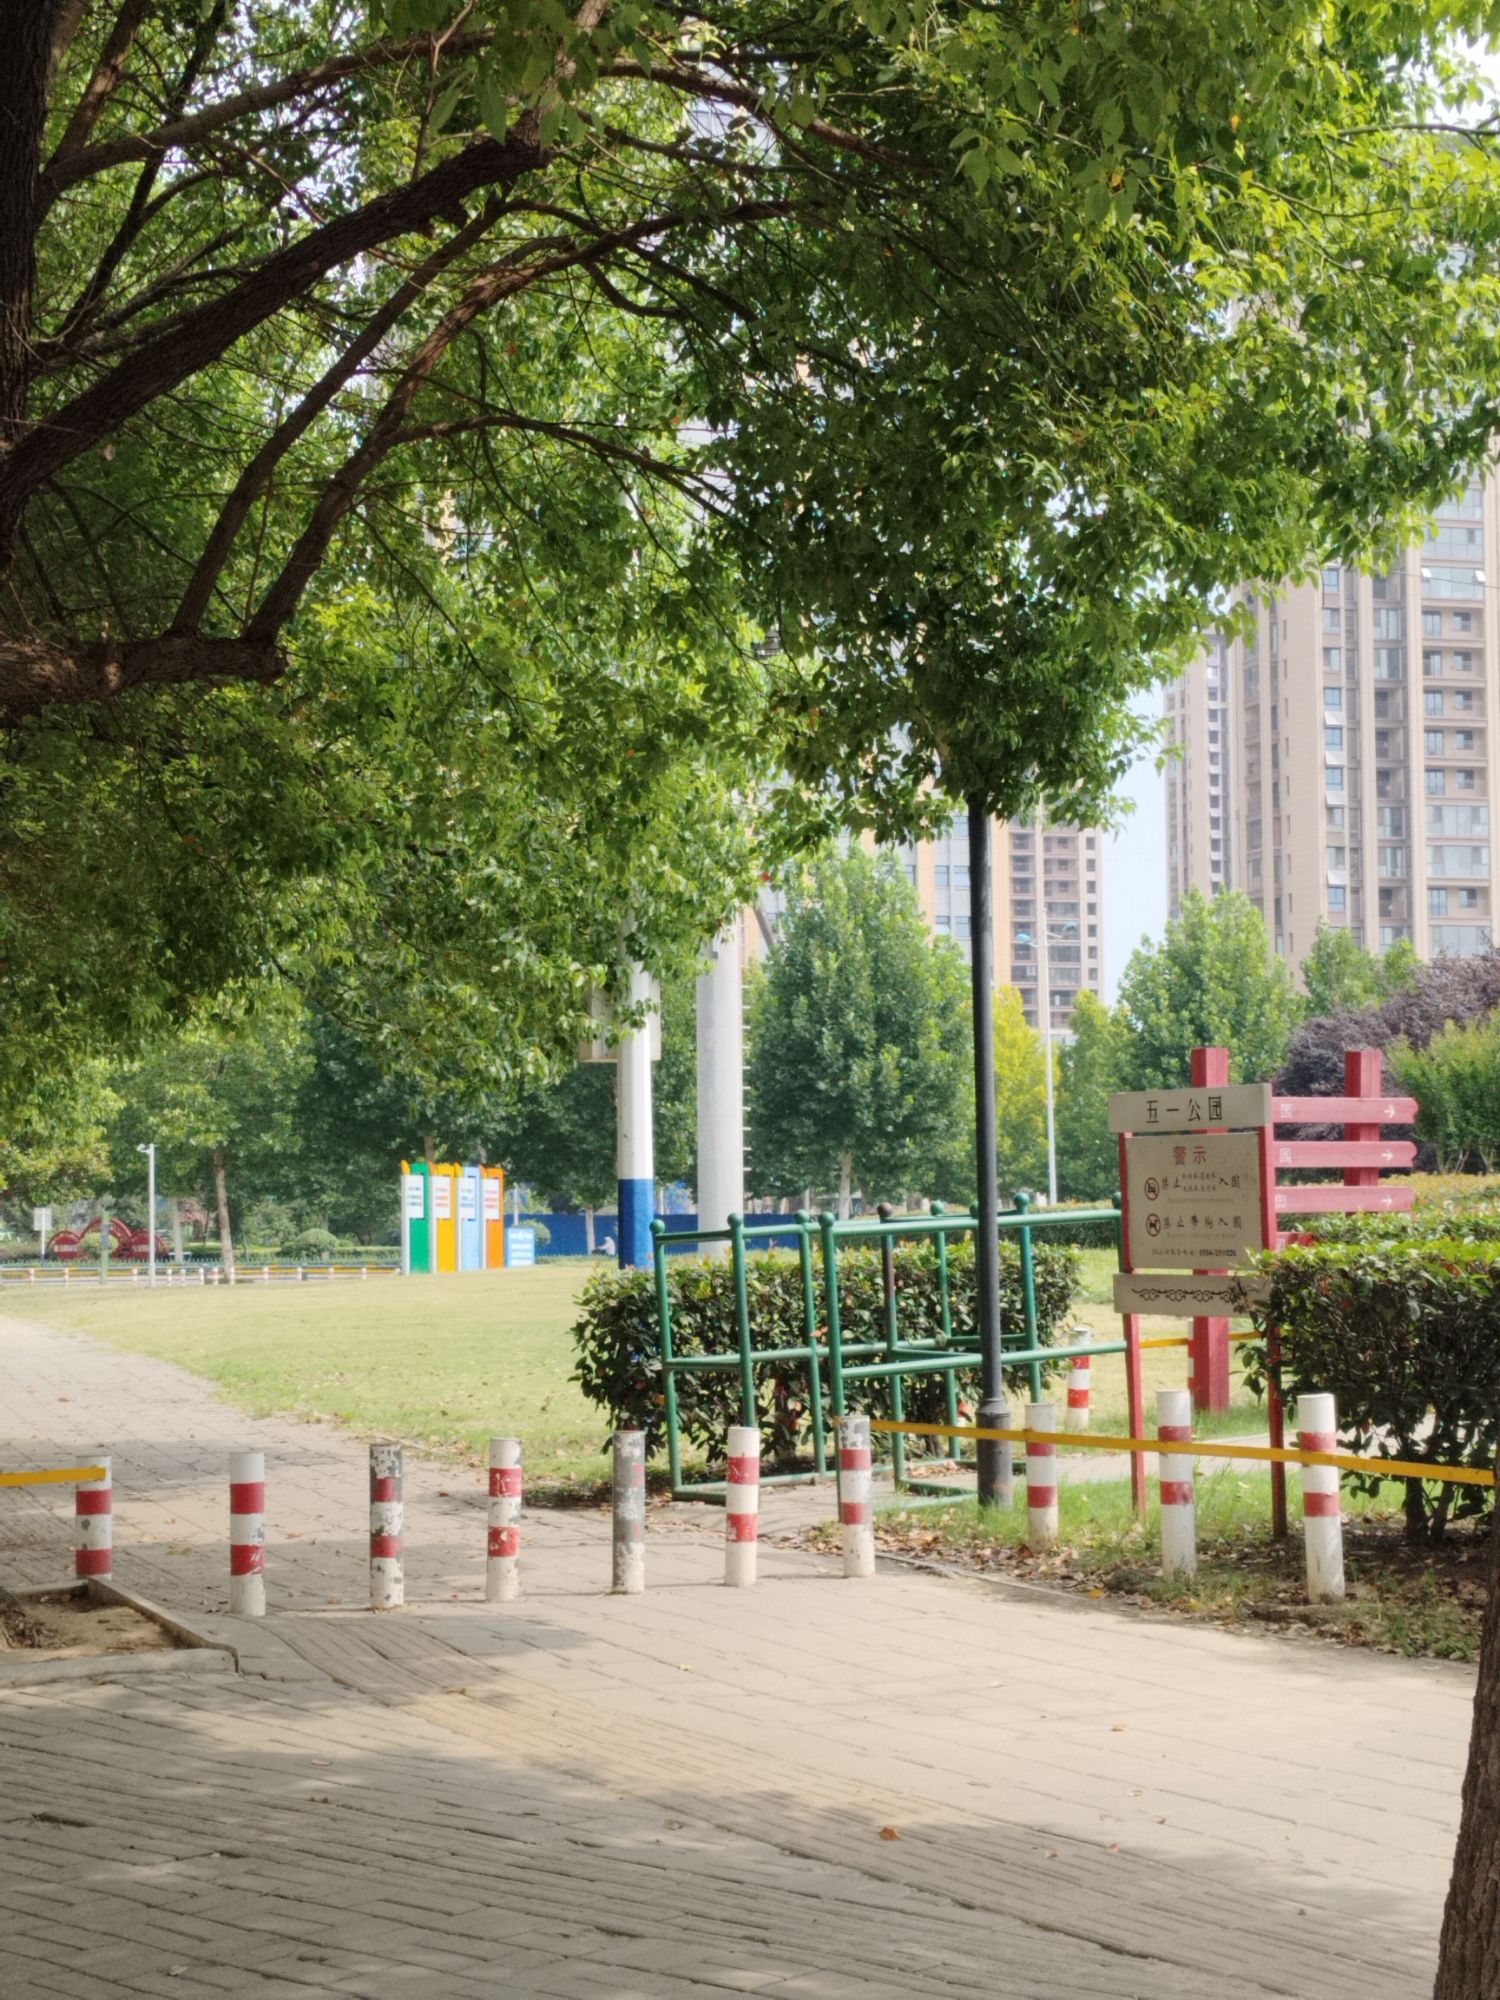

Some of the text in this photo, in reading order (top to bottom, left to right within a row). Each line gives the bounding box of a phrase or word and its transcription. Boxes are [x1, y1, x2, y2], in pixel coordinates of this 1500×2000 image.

[1146, 1096, 1223, 1124] 五一公园
[1173, 1146, 1207, 1166] 警示
